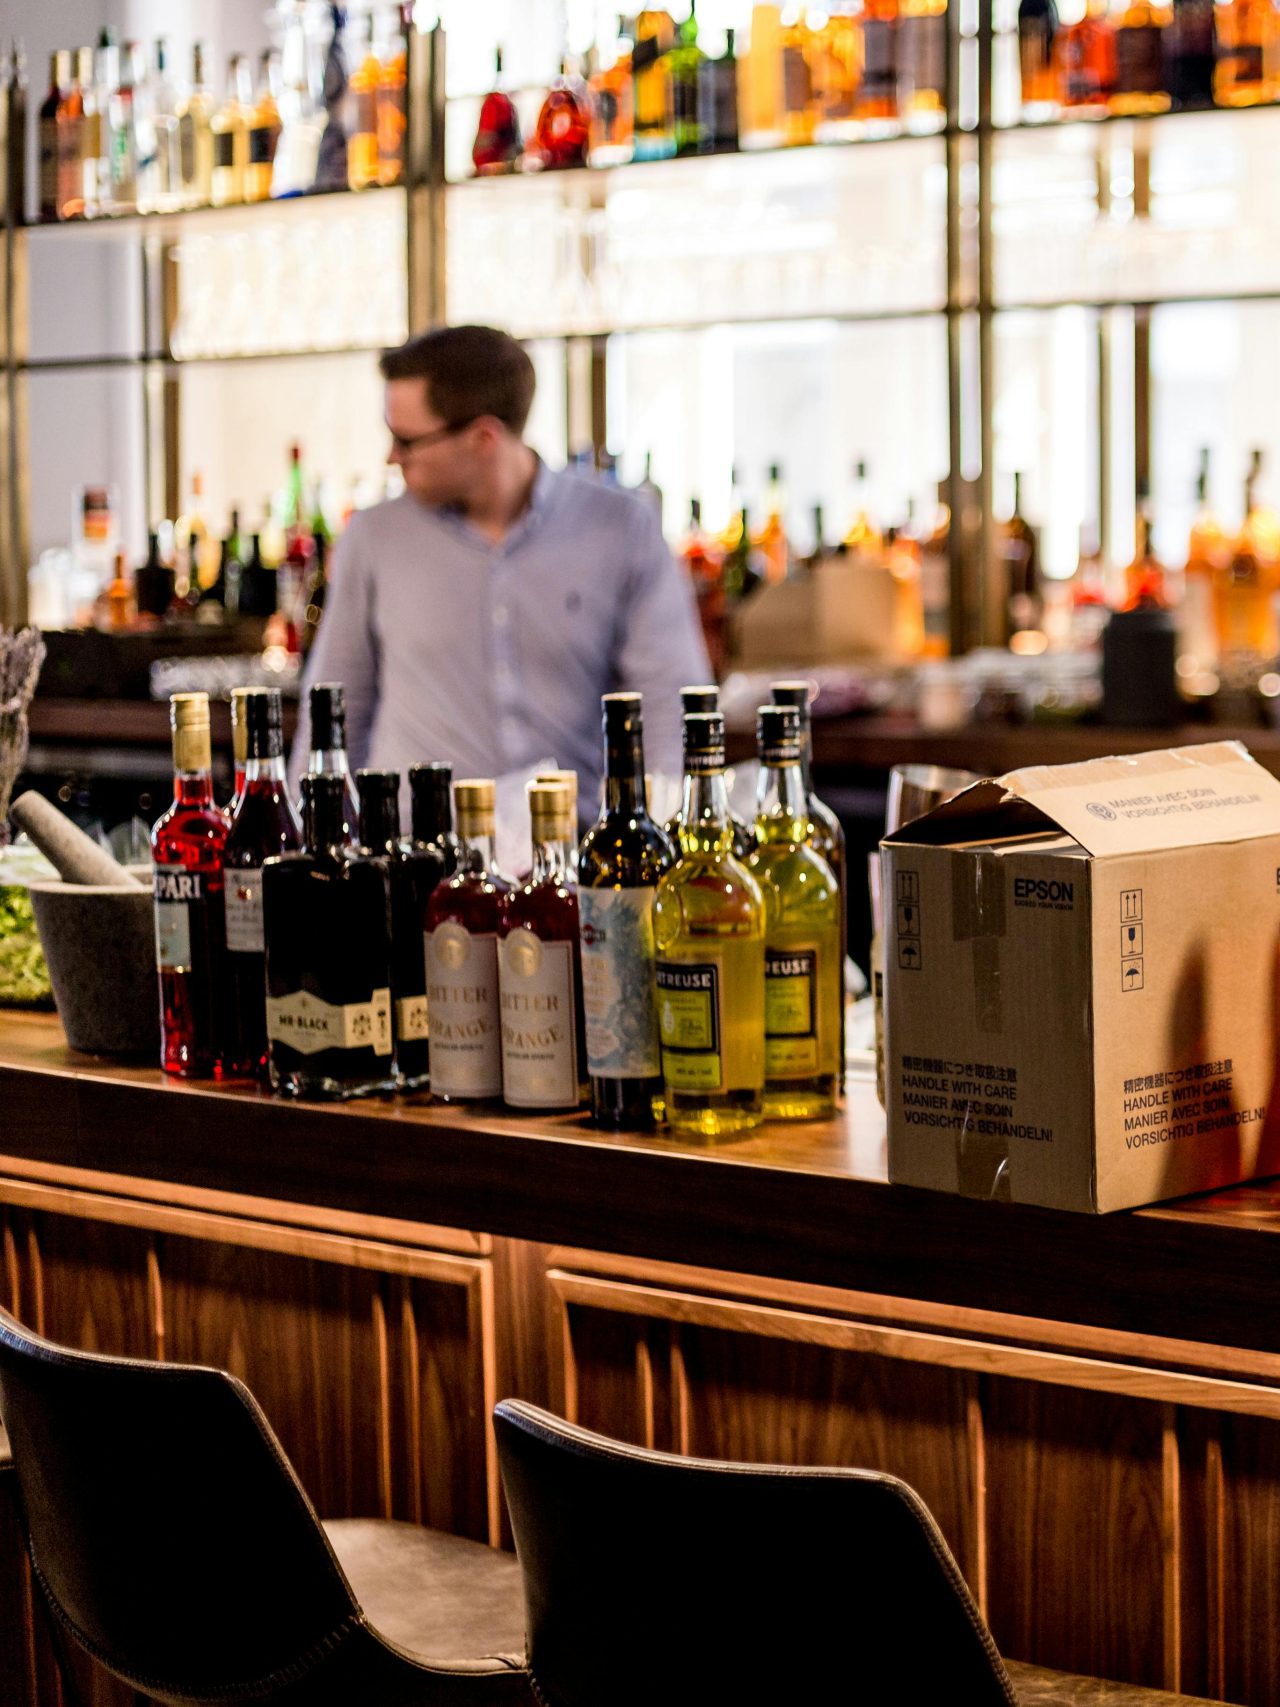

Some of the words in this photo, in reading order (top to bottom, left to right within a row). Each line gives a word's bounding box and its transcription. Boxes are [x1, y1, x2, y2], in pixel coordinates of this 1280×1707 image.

[1015, 879, 1073, 902] EPSON
[297, 1017, 328, 1031] BLACK
[902, 1074, 949, 1092] HANDLE
[952, 1081, 981, 1096] WITH
[984, 1084, 1016, 1100] CARE
[1124, 1058, 1233, 1094] 精密機器につき取扱注意
[903, 1092, 948, 1110] MANIER
[951, 1098, 982, 1113] AVEC
[985, 1103, 1013, 1118] SOIN
[1124, 1091, 1169, 1113] HANDLE
[1172, 1085, 1200, 1102] WITH
[1203, 1077, 1232, 1096] CARE
[1124, 1110, 1168, 1132] MANIER
[1171, 1102, 1200, 1121] AVEC
[1203, 1096, 1229, 1114] SOIN
[978, 1119, 1053, 1142] BEHANDELN!
[1126, 1124, 1194, 1150] VORSICHTIG
[1197, 1106, 1265, 1135] BEHANDELN!
